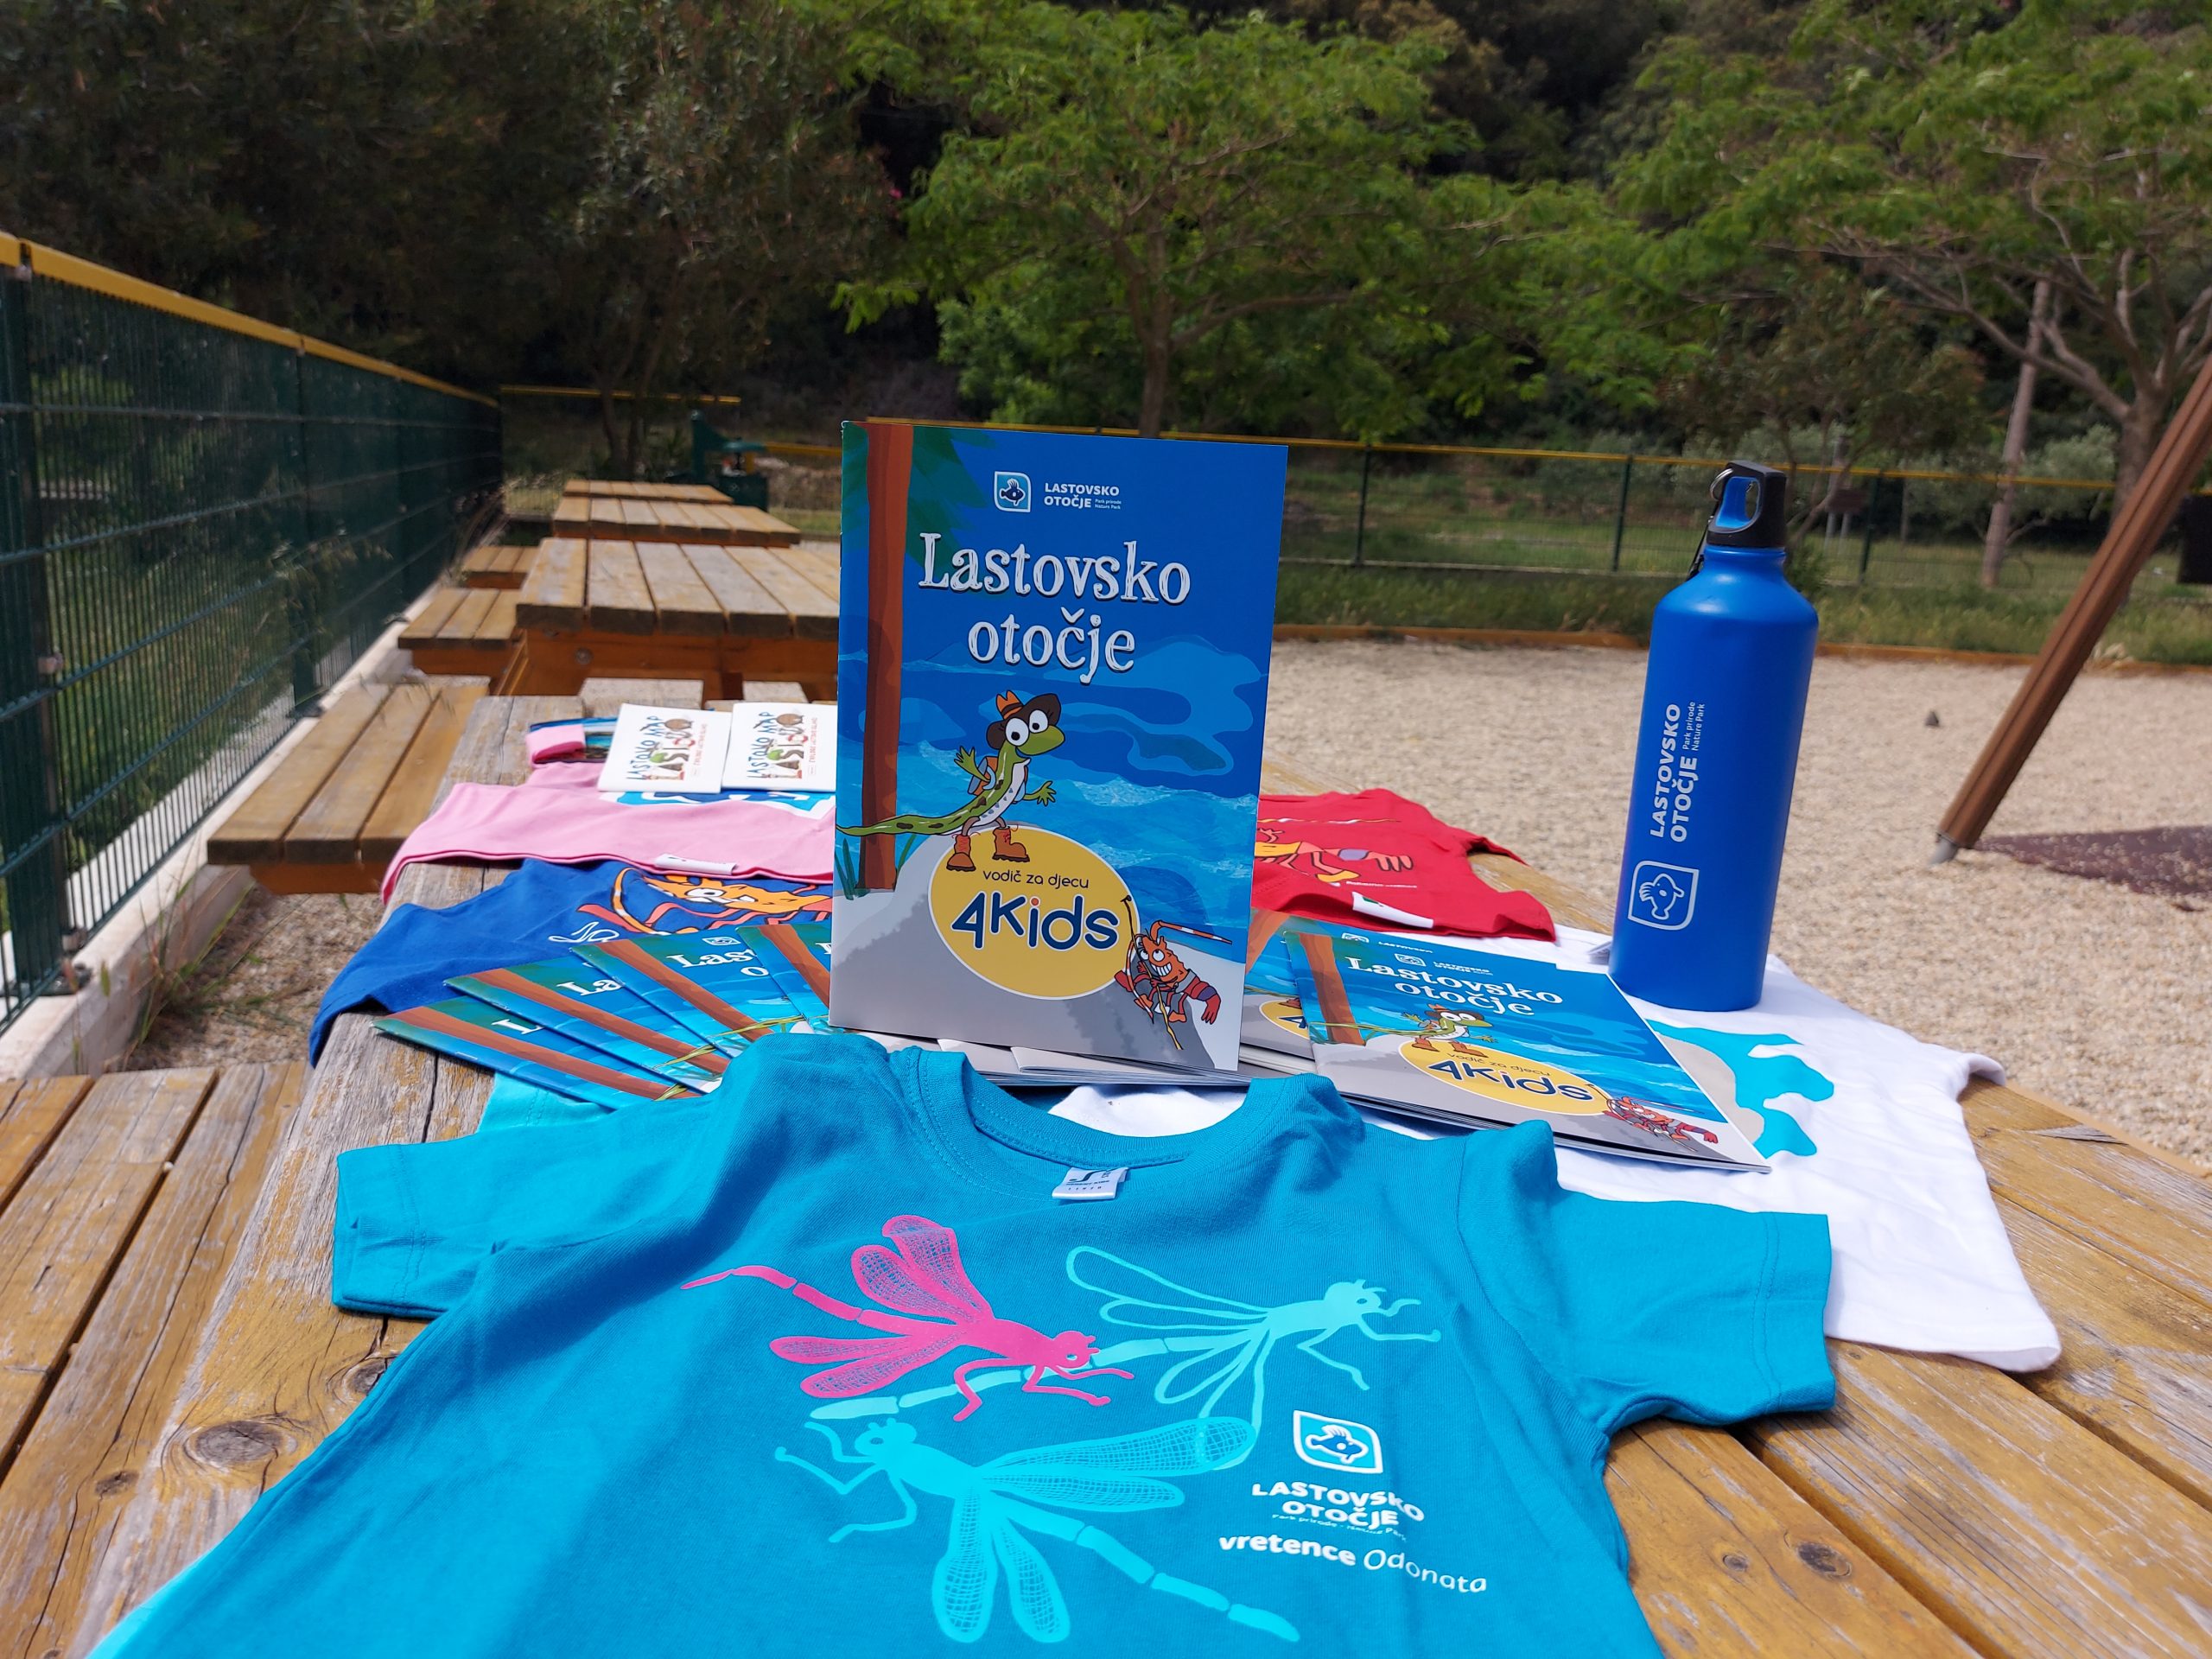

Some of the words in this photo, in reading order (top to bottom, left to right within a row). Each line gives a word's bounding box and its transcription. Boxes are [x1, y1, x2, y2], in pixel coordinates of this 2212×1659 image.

[1044, 494, 1092, 509] OTOČJE
[1045, 482, 1120, 497] LASTOVSKO
[918, 532, 1191, 604] Lastovsko
[968, 607, 1135, 683] otočje
[1685, 702, 1696, 731] prirode
[1695, 703, 1706, 721] Park
[1682, 732, 1692, 750] Park
[1691, 723, 1702, 751] Nature
[1650, 703, 1681, 838] LASTOVSKO
[1670, 756, 1699, 842] OTOČJE
[982, 869, 1021, 883] vodič
[1026, 874, 1044, 886] za
[1047, 874, 1089, 890] djecu
[951, 891, 1120, 950] 4Kids
[1344, 957, 1563, 1004] Lastovsko
[1395, 982, 1535, 1016] otočje
[1427, 1059, 1594, 1102] 4Kids
[1446, 1052, 1486, 1064] vodič
[1510, 1065, 1550, 1077] djecu
[1251, 1481, 1426, 1522] LASTOVSKO
[1281, 1501, 1399, 1530] OTOČJE
[1219, 1534, 1357, 1567] vretence
[1363, 1548, 1487, 1593] Odonata
